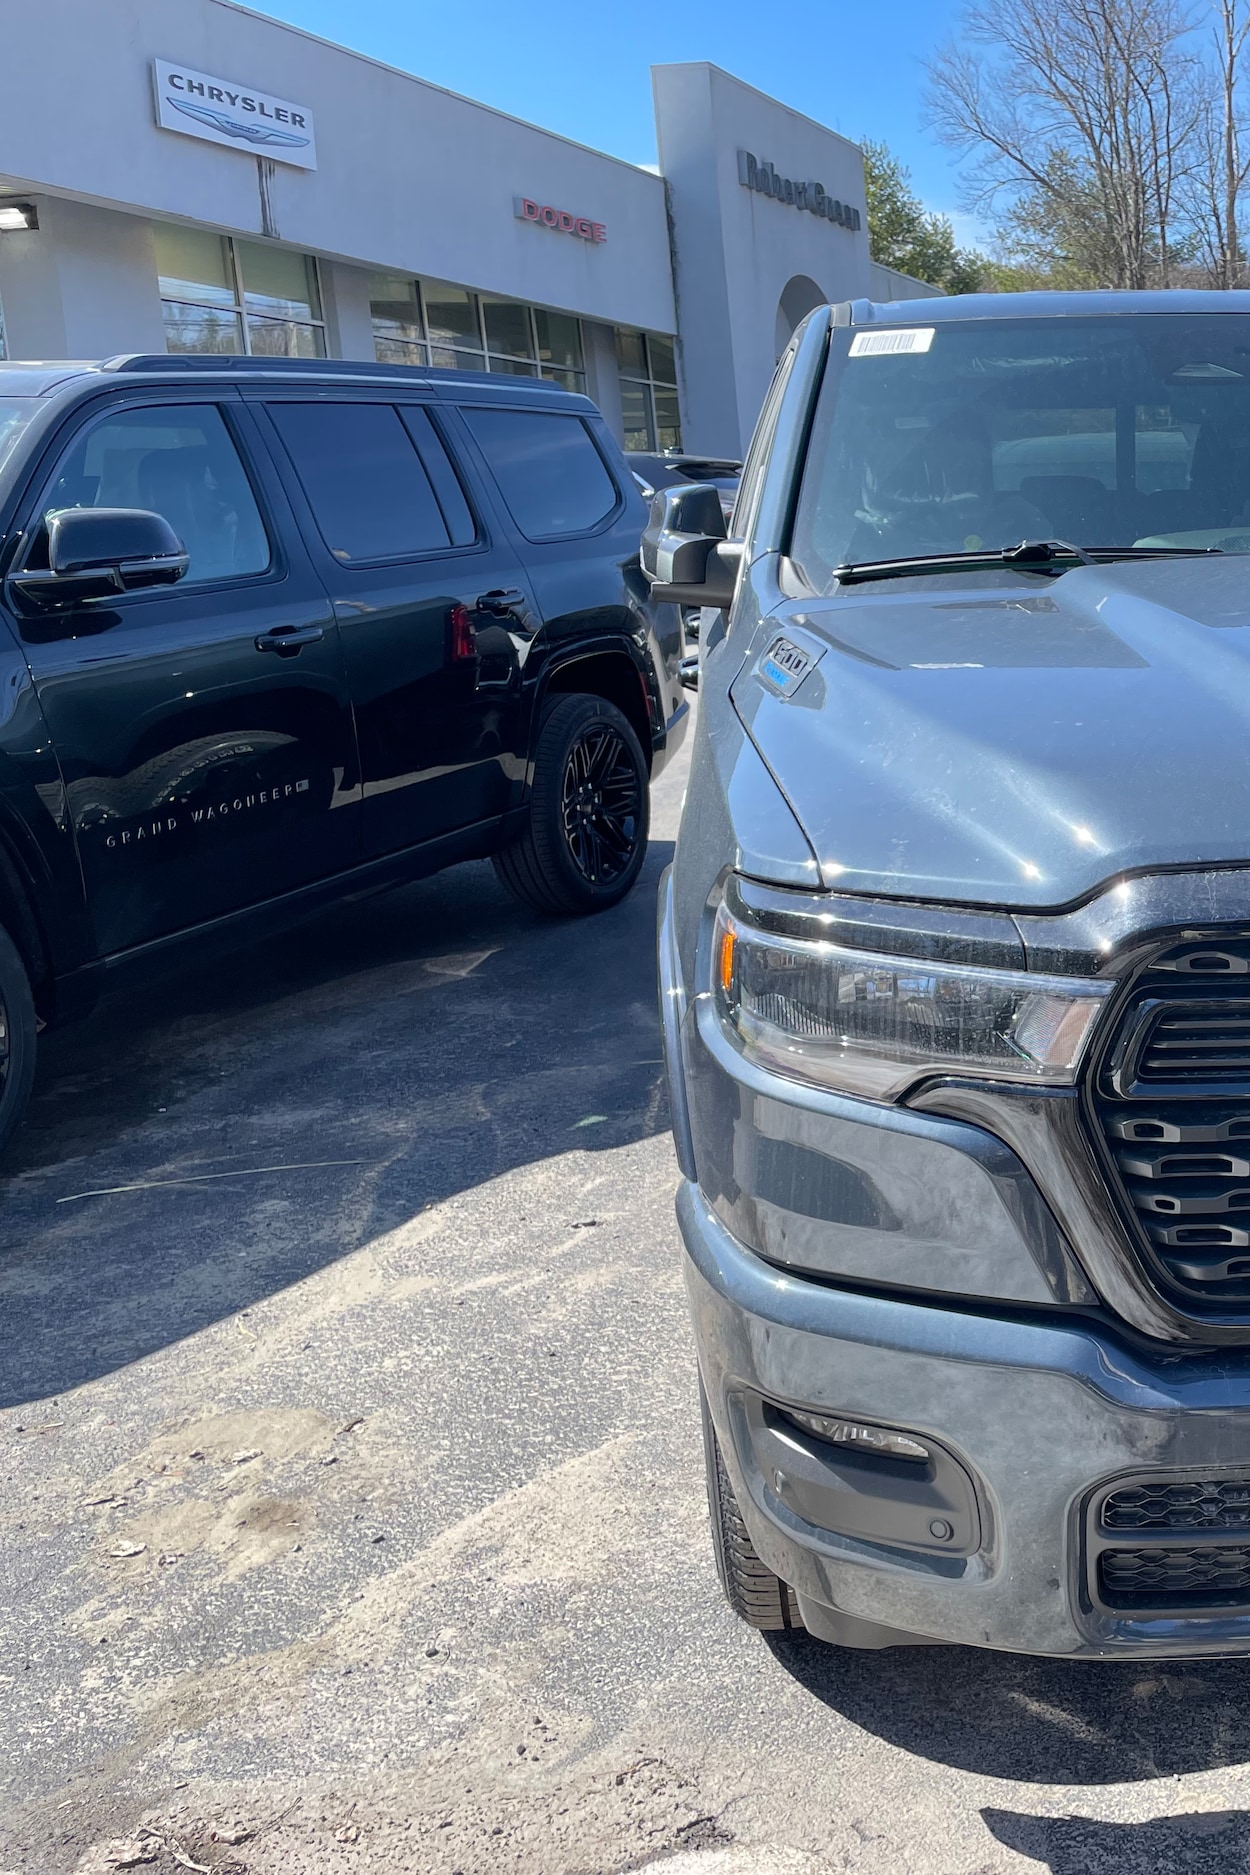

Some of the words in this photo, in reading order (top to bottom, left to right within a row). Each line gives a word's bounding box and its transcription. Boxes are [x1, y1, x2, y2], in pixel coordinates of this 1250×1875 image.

[168, 74, 306, 129] CHRYSLER
[519, 197, 608, 244] DODGE
[105, 817, 177, 848] GRAND
[190, 783, 293, 823] WAGONEER
